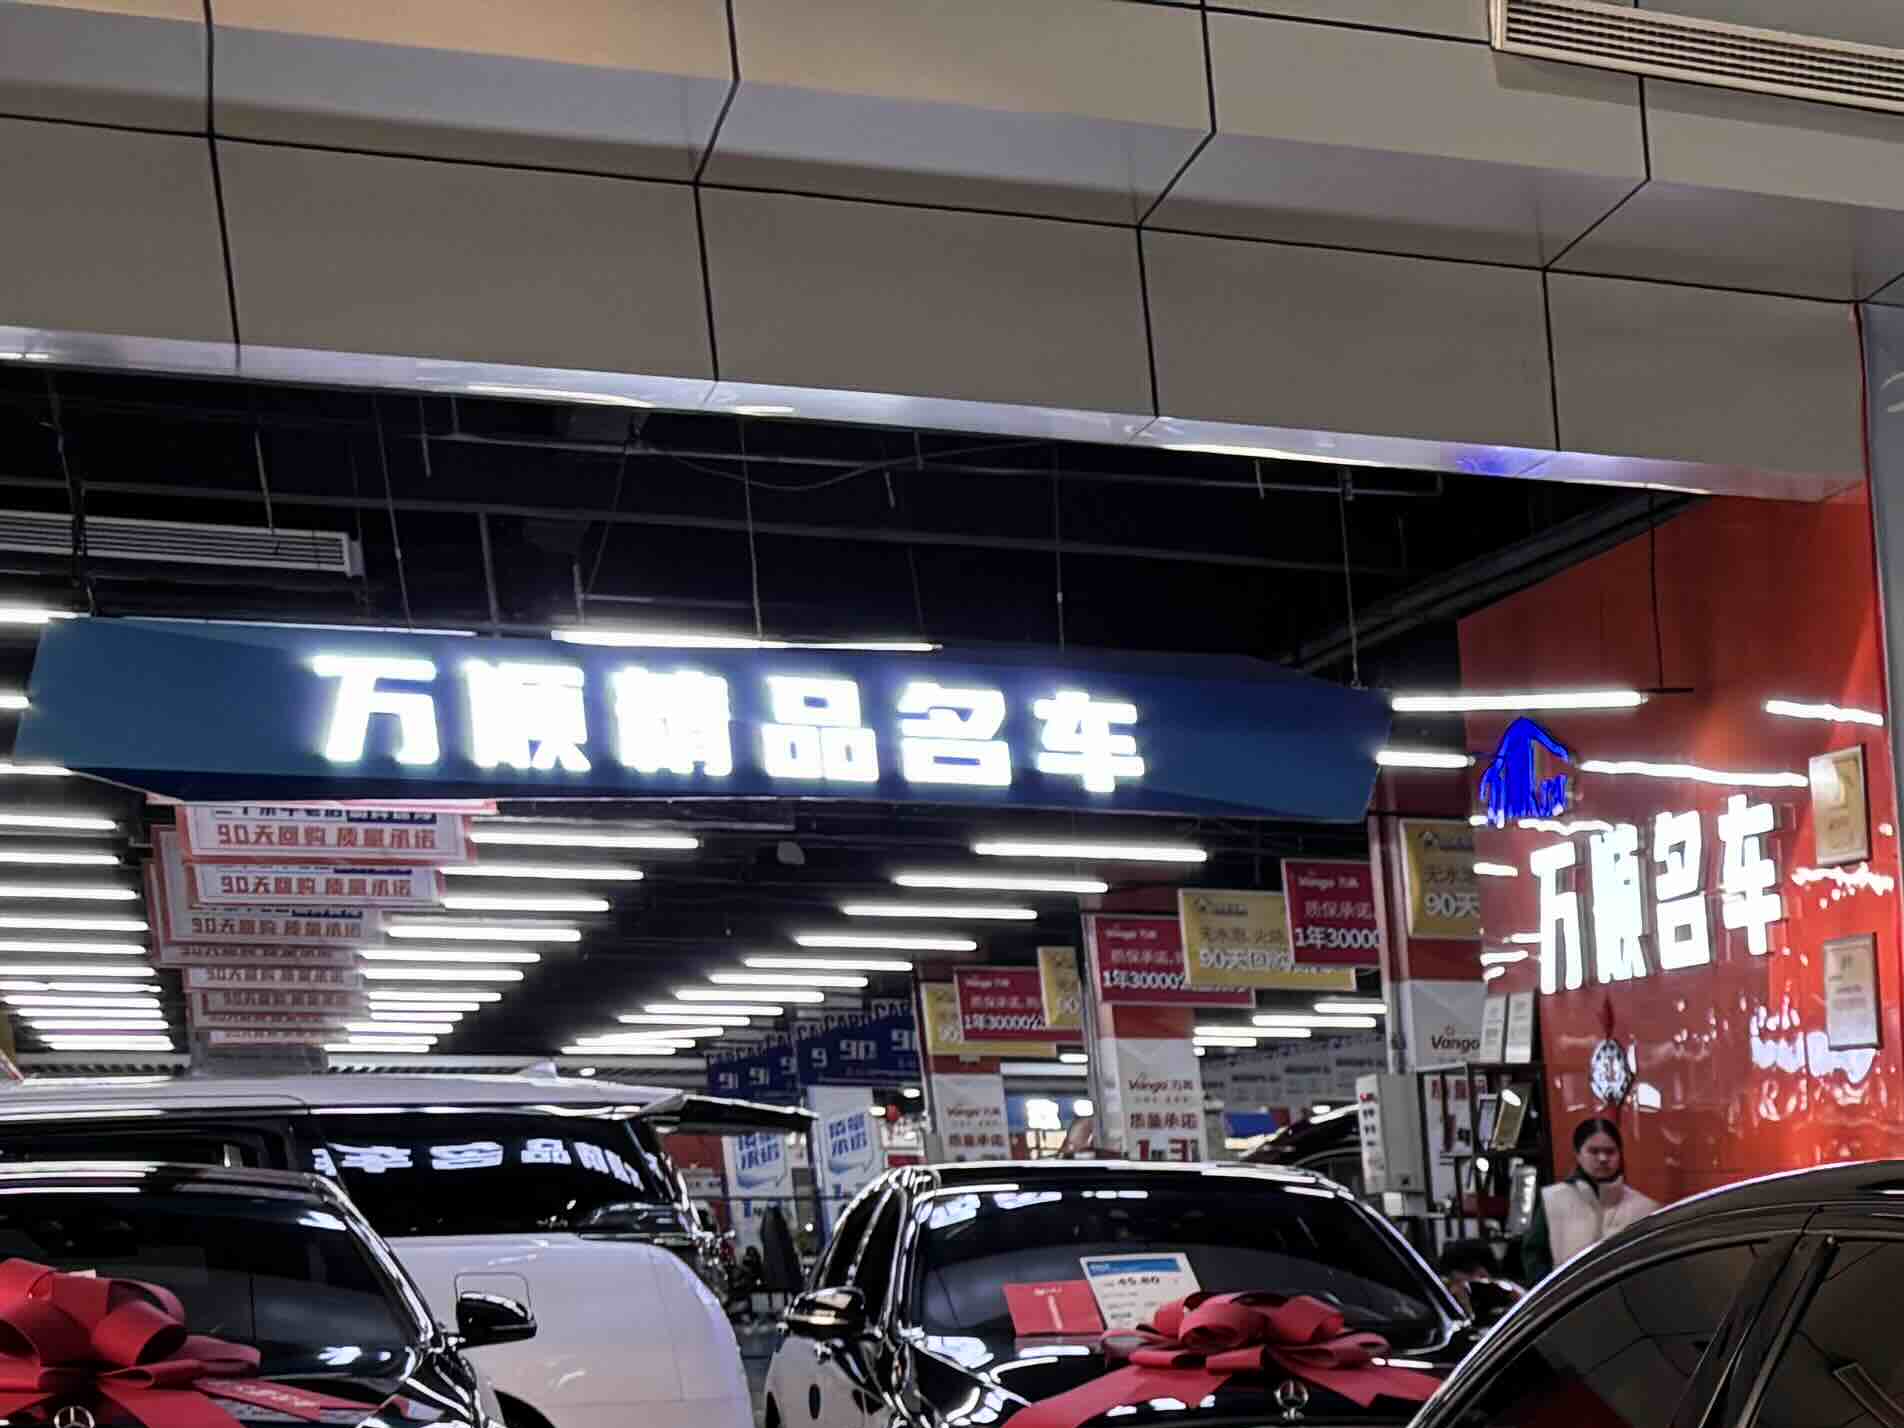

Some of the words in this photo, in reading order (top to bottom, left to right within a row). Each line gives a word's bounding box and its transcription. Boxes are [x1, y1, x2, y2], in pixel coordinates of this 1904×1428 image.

[312, 655, 1146, 792] 万顺精品名车
[1530, 793, 1783, 995] 万顺名车
